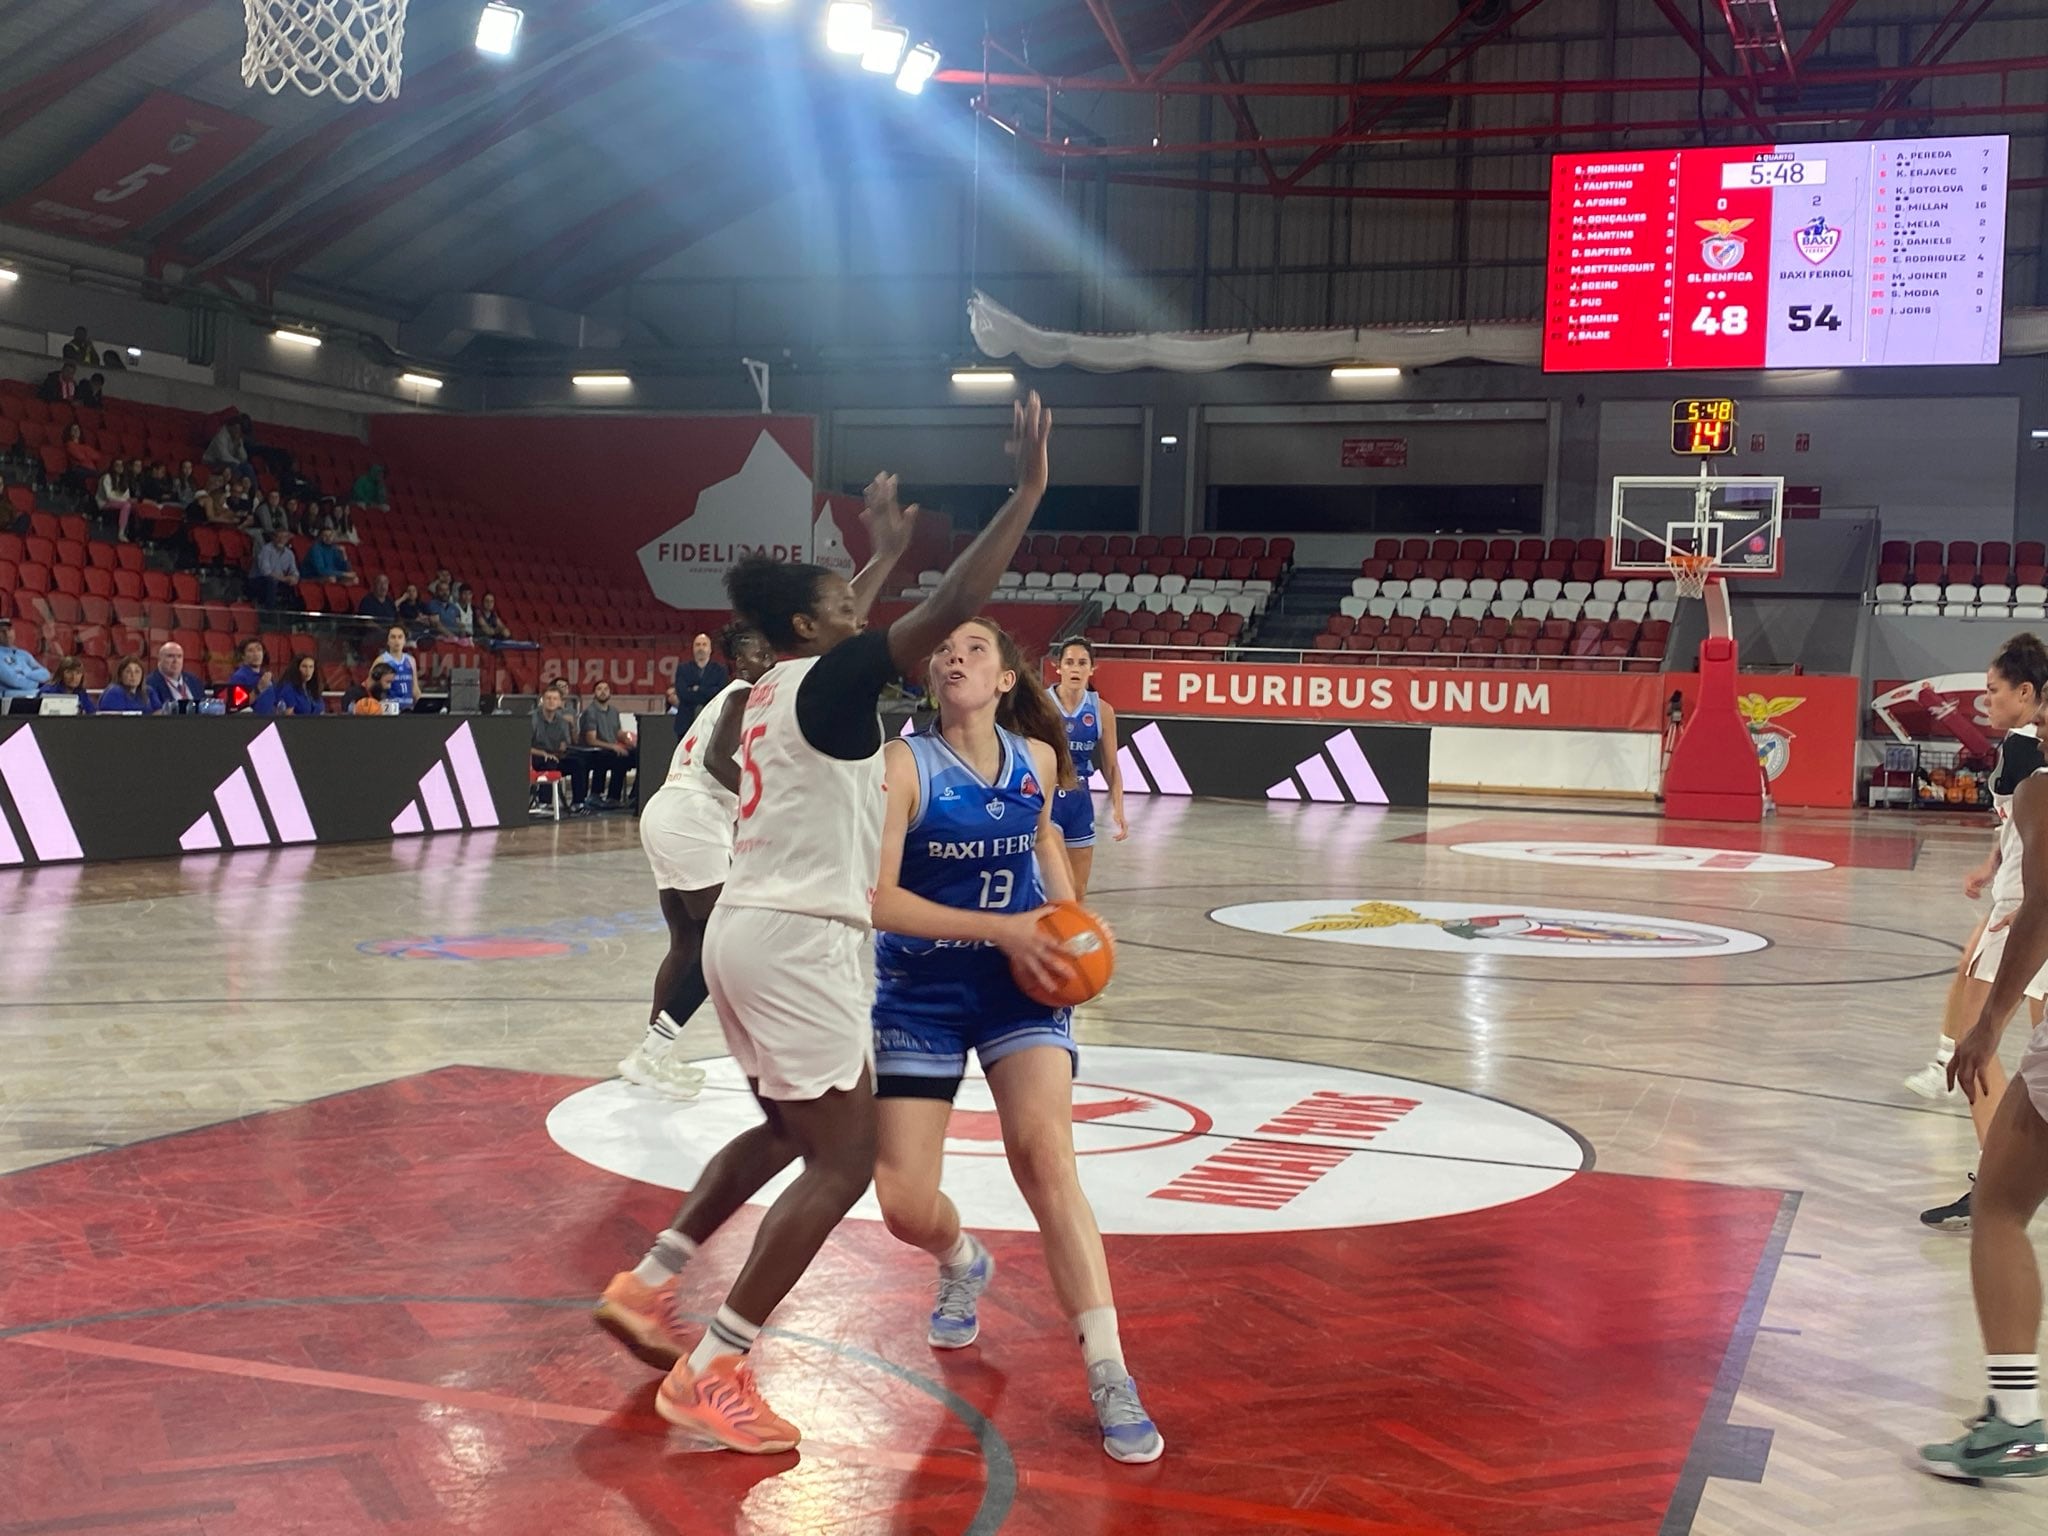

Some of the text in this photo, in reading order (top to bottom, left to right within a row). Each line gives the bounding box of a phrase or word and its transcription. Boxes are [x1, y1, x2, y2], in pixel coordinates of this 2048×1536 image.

[1911, 151, 1952, 159] PEREDA
[1587, 163, 1644, 174] RODRIGUES
[1750, 163, 1804, 184] 5:48
[1910, 168, 1957, 176] ERJAVEC
[1583, 180, 1633, 190] FAUSTINO
[1909, 185, 1963, 193] SOTOLOVA
[1573, 200, 1584, 208] A.
[1586, 198, 1627, 207] AFONSO
[1717, 198, 1727, 211] 0
[1812, 196, 1821, 206] 2
[1573, 216, 1587, 224] M.
[1588, 214, 1646, 224] GONÇALVES
[1572, 232, 1586, 241] M.
[1587, 230, 1634, 240] MARTINS
[1802, 236, 1833, 245] BAXI
[1907, 237, 1951, 245] DANIELS
[1584, 247, 1632, 257] BAPTISTA
[1905, 254, 1966, 262] RODRIGUEZ
[1703, 272, 1753, 282] BENFICA
[1780, 270, 1853, 279] BAXI FERROL
[1908, 272, 1947, 280] JOINER
[1580, 314, 1619, 323] SOARES
[1691, 305, 1748, 335] 48
[1788, 304, 1842, 331] 54
[1688, 402, 1731, 421] 5:48
[1694, 421, 1720, 447] 14
[1142, 673, 1551, 715] E PLURIBUS UNUM
[928, 840, 984, 859] BAXI
[978, 869, 1014, 909] 13
